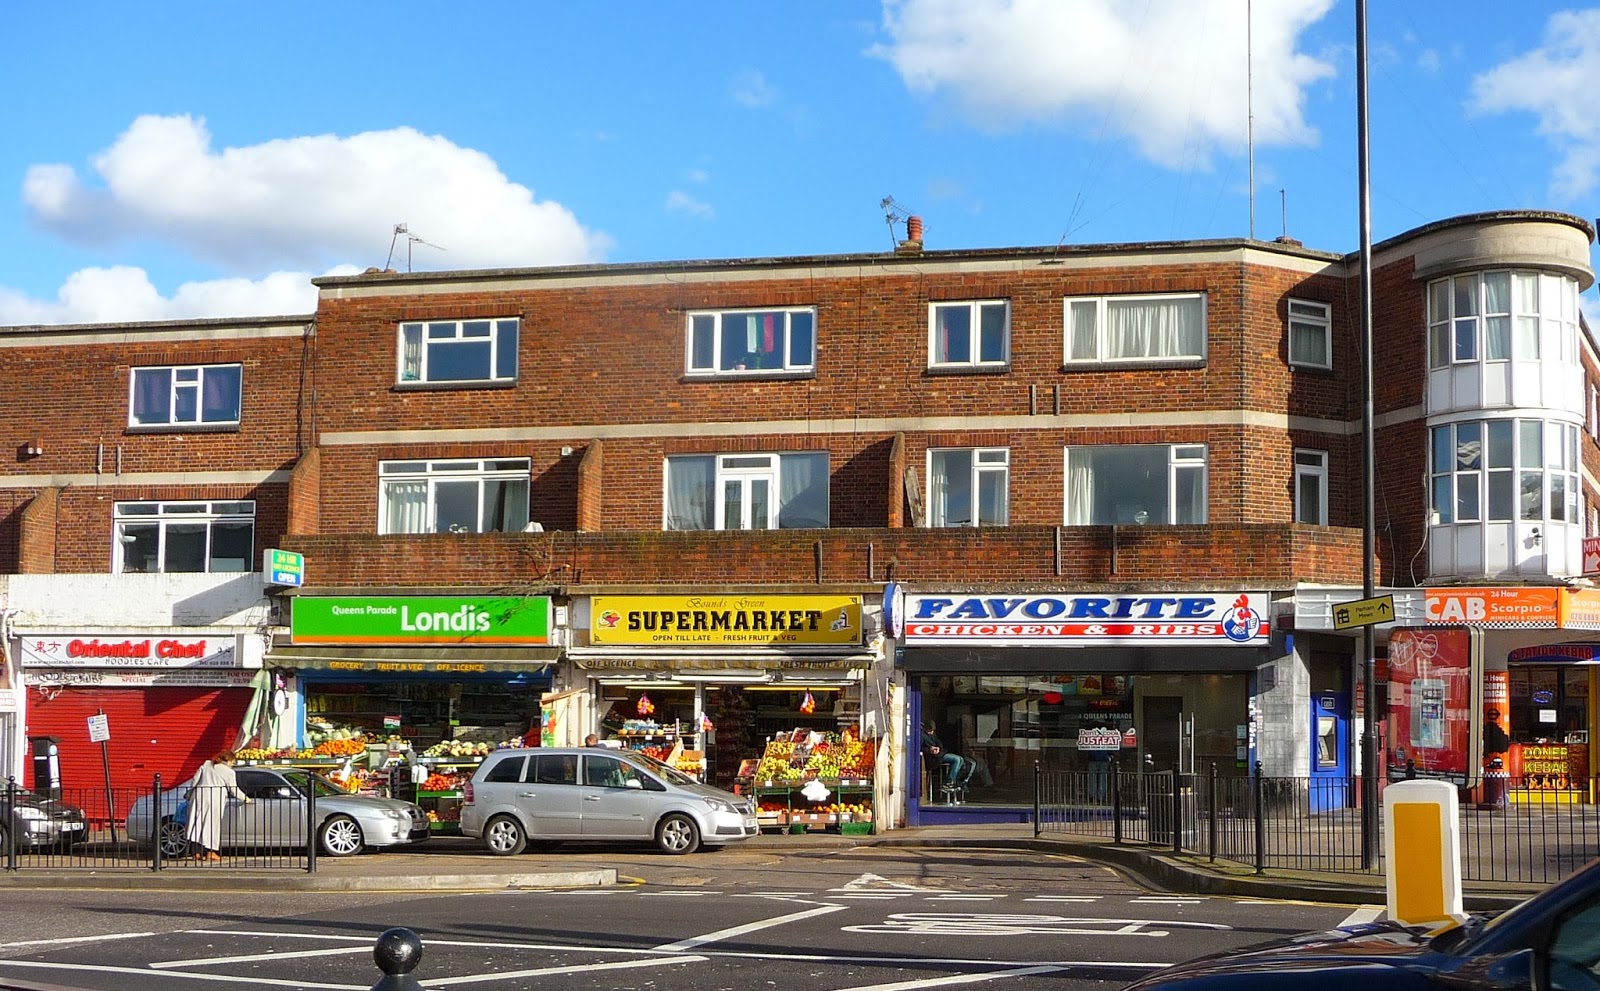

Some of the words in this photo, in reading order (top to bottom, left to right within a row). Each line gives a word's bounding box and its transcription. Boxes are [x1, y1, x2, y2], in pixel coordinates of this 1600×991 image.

[277, 552, 286, 563] 24
[286, 554, 297, 565] HR
[278, 572, 296, 584] OPEN
[1501, 590, 1518, 598] Hour
[332, 605, 364, 615] Queens
[366, 605, 397, 614] Parade
[686, 597, 728, 608] Bounds
[733, 597, 765, 611] Green
[912, 597, 1215, 619] FAVORITE
[1426, 597, 1486, 621] CAB
[1491, 603, 1542, 615] Scorpio
[401, 605, 490, 631] Londis
[628, 610, 822, 632] SUPERMARKET
[913, 625, 1065, 635] CHICKEN
[1083, 625, 1108, 635] &
[1130, 625, 1217, 635] RIBS
[34, 641, 61, 656] 東方
[67, 639, 151, 658] Oriental
[155, 639, 207, 659] Chef
[1512, 646, 1555, 660] STATION
[1559, 646, 1592, 660] KEBAB
[105, 658, 144, 666] NOODLES
[147, 658, 170, 666] CAFE
[329, 661, 364, 670] GROCERY
[377, 662, 399, 671] FRUIT
[408, 663, 423, 671] VEG
[436, 663, 450, 671] OFF
[1489, 674, 1505, 682] Hour
[1078, 736, 1101, 745] JUST
[1102, 736, 1119, 745] EAT
[1524, 747, 1568, 760] DONER
[1524, 761, 1569, 774] KEBAB
